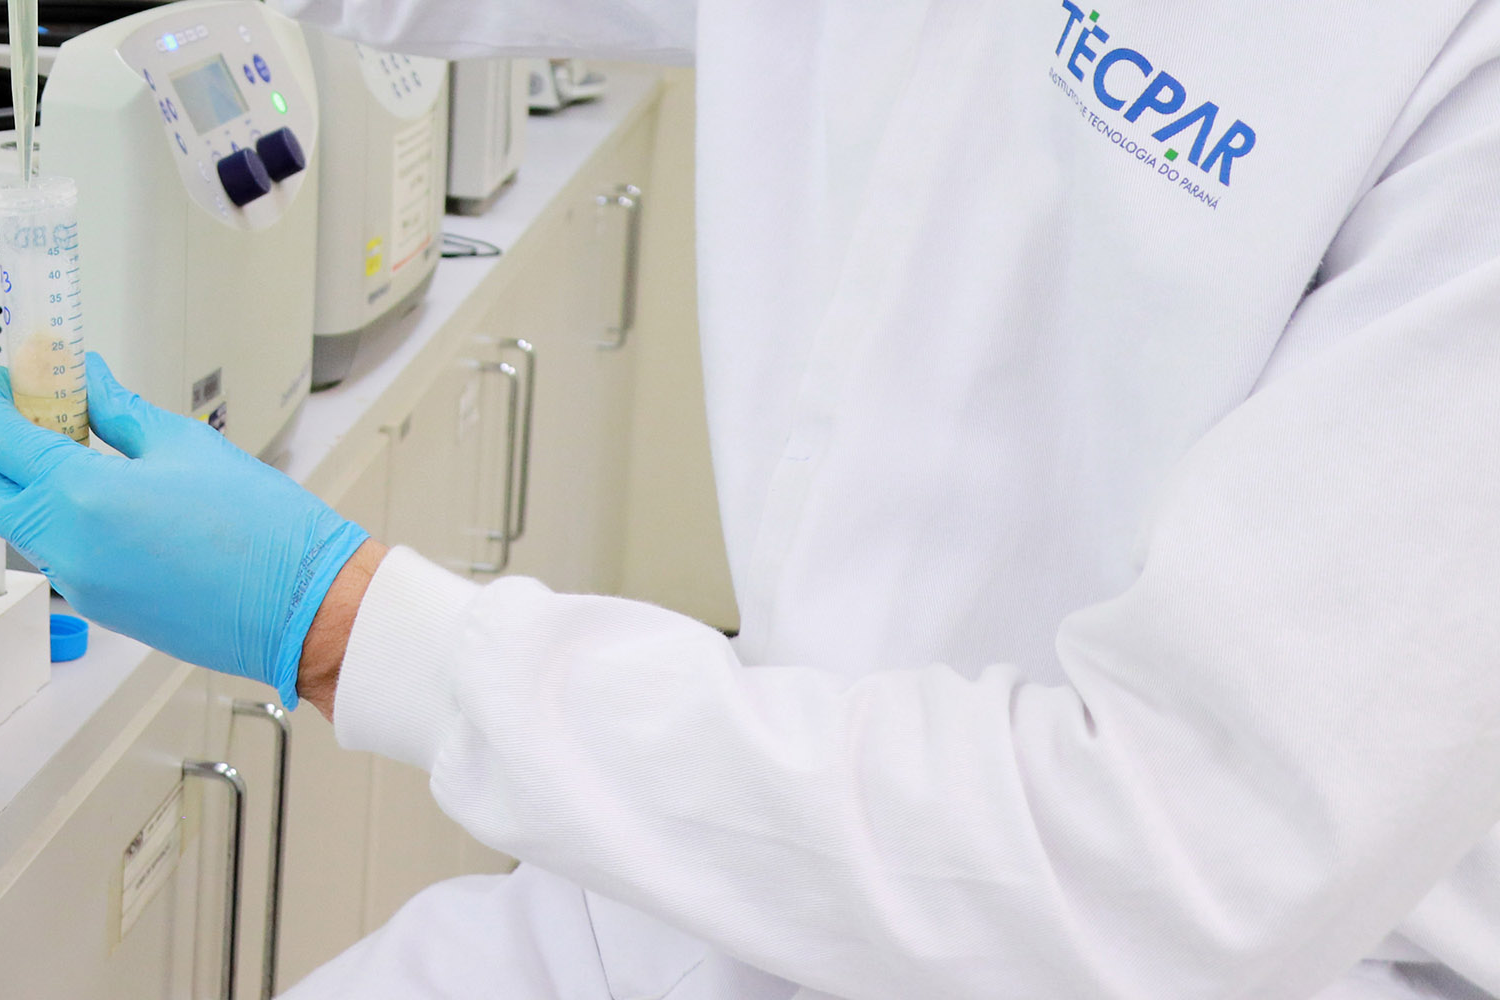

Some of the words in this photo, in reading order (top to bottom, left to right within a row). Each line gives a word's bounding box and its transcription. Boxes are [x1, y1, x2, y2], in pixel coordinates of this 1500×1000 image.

[1088, 111, 1157, 168] TECNOLOGIA
[1158, 163, 1180, 182] DO
[47, 247, 60, 256] 45
[48, 271, 61, 279] 40
[50, 294, 62, 303] 35
[51, 317, 63, 326] 30
[52, 341, 64, 350] 25
[53, 366, 65, 375] 20
[54, 390, 66, 399] 15
[56, 414, 68, 423] 10
